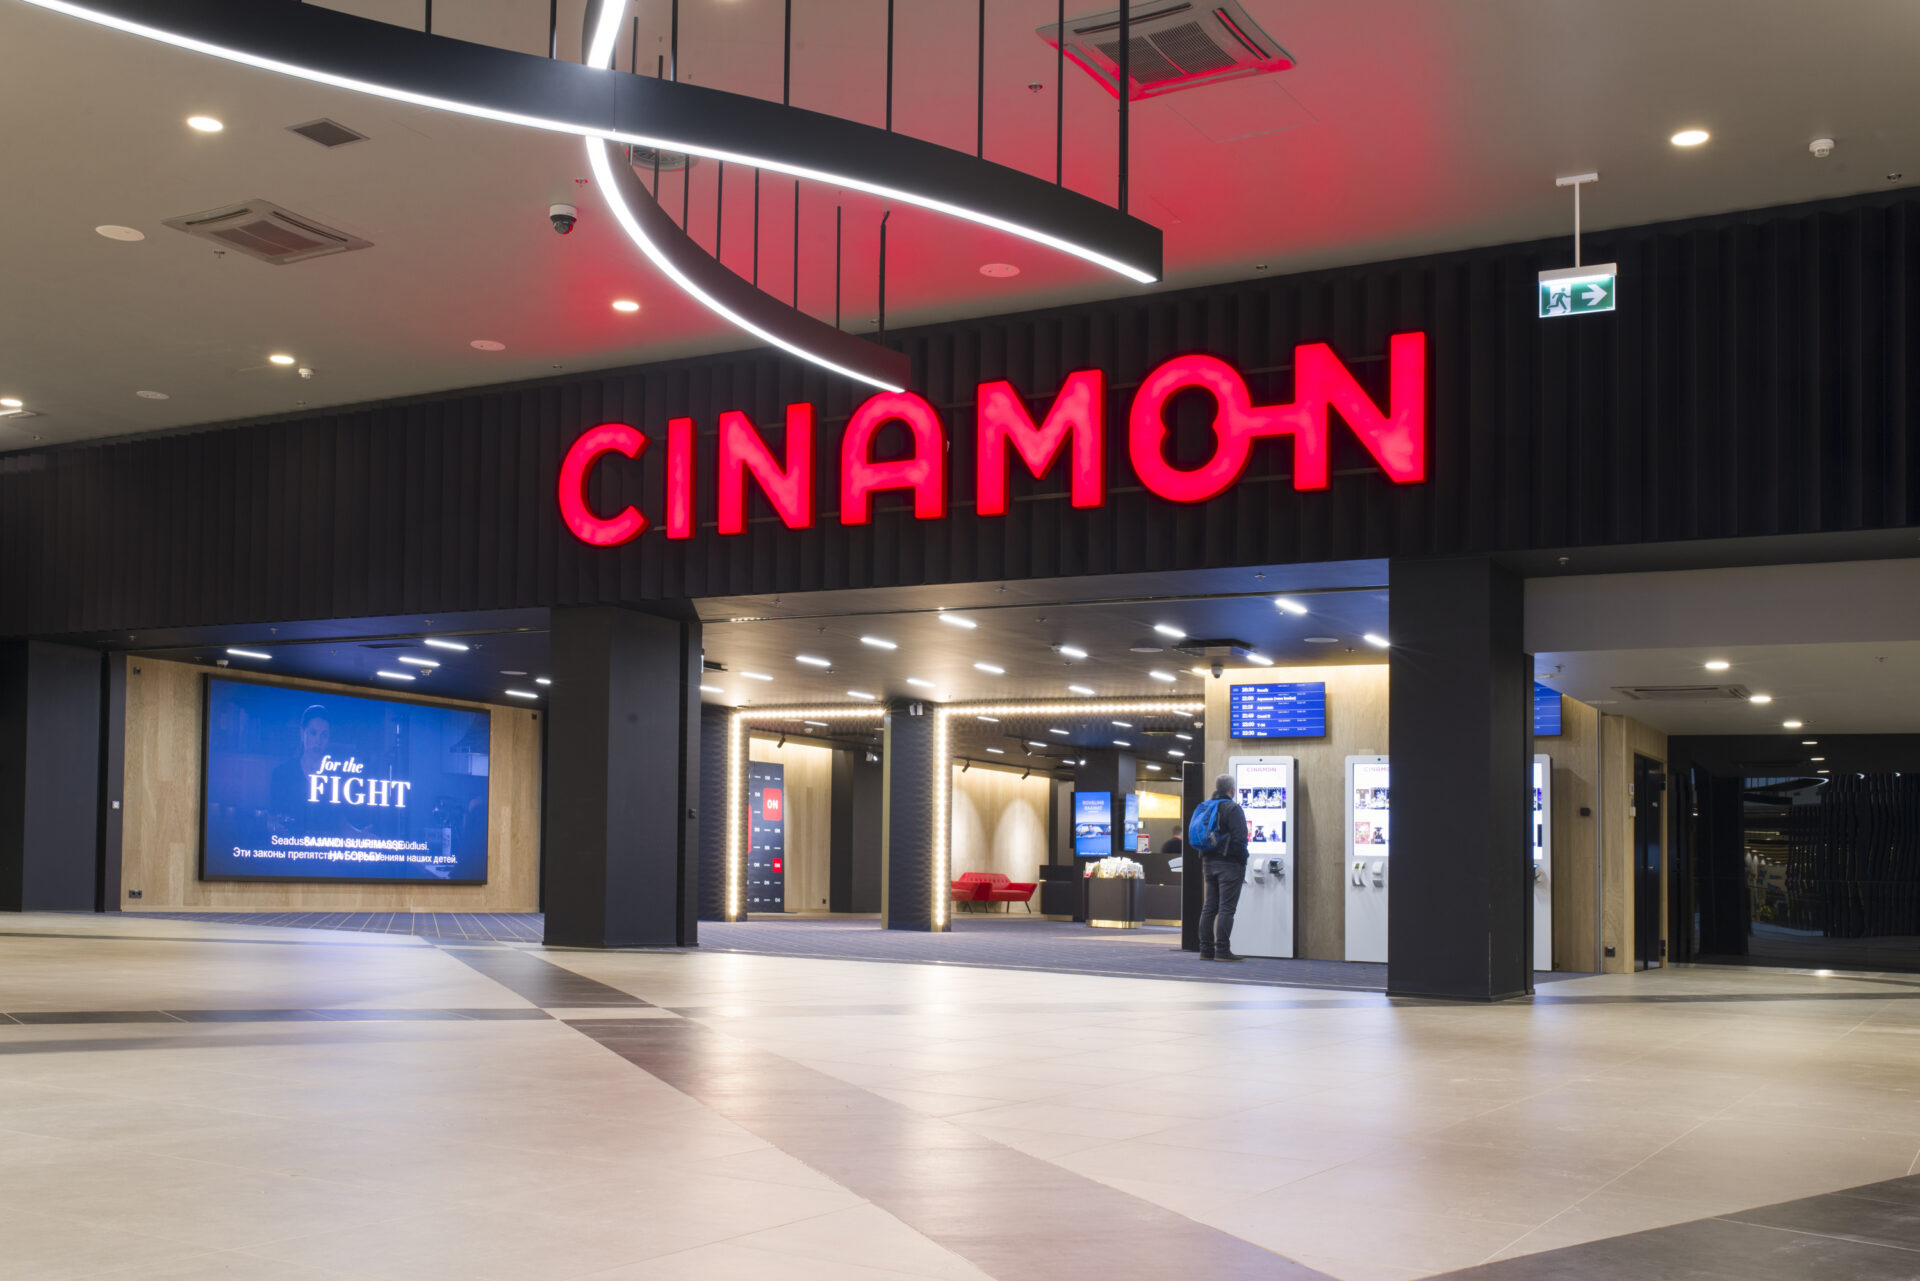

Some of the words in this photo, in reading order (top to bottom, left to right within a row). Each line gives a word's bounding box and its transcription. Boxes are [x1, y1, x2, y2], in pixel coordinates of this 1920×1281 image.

[558, 331, 1427, 547] CINAMON
[316, 755, 341, 774] for
[342, 757, 363, 773] the
[308, 774, 411, 807] FIGHT
[233, 847, 250, 857] Эти
[252, 850, 285, 859] законы
[407, 855, 432, 863] наших
